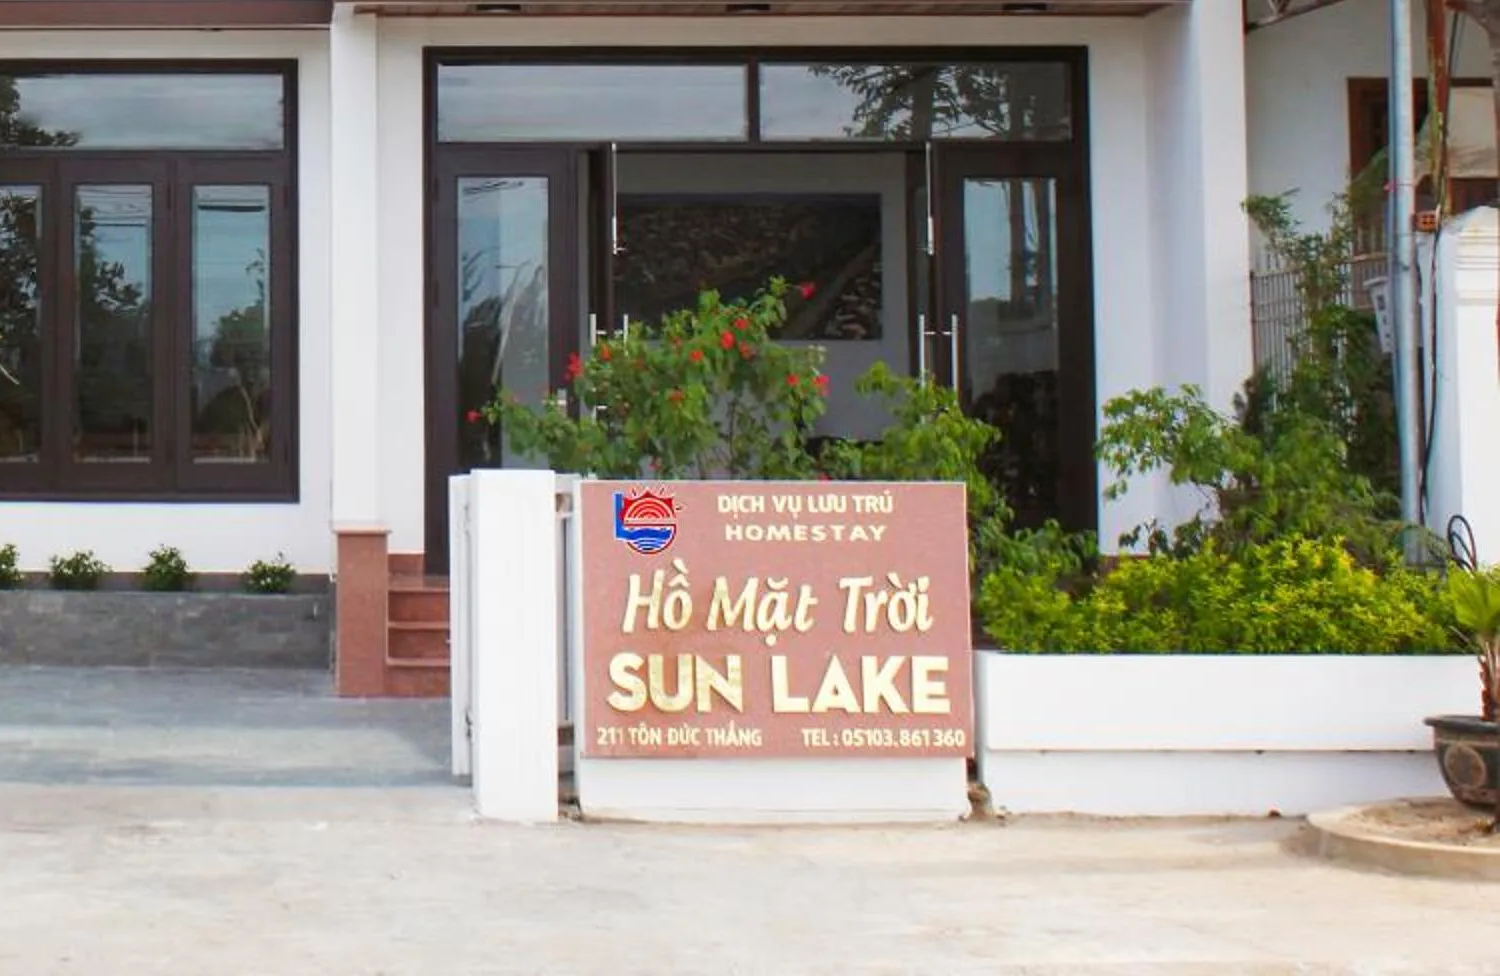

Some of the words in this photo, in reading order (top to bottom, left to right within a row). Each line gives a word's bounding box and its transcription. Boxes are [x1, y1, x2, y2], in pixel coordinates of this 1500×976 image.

[717, 495, 765, 520] DỊCH
[771, 495, 801, 520] VỤ
[725, 524, 887, 541] HOMESTAY
[622, 557, 693, 633] Hồ
[706, 576, 819, 647] Mặt
[838, 571, 934, 633] Trời
[607, 651, 743, 713] SUN
[771, 652, 951, 714] LAKE
[627, 721, 662, 746] TÔN
